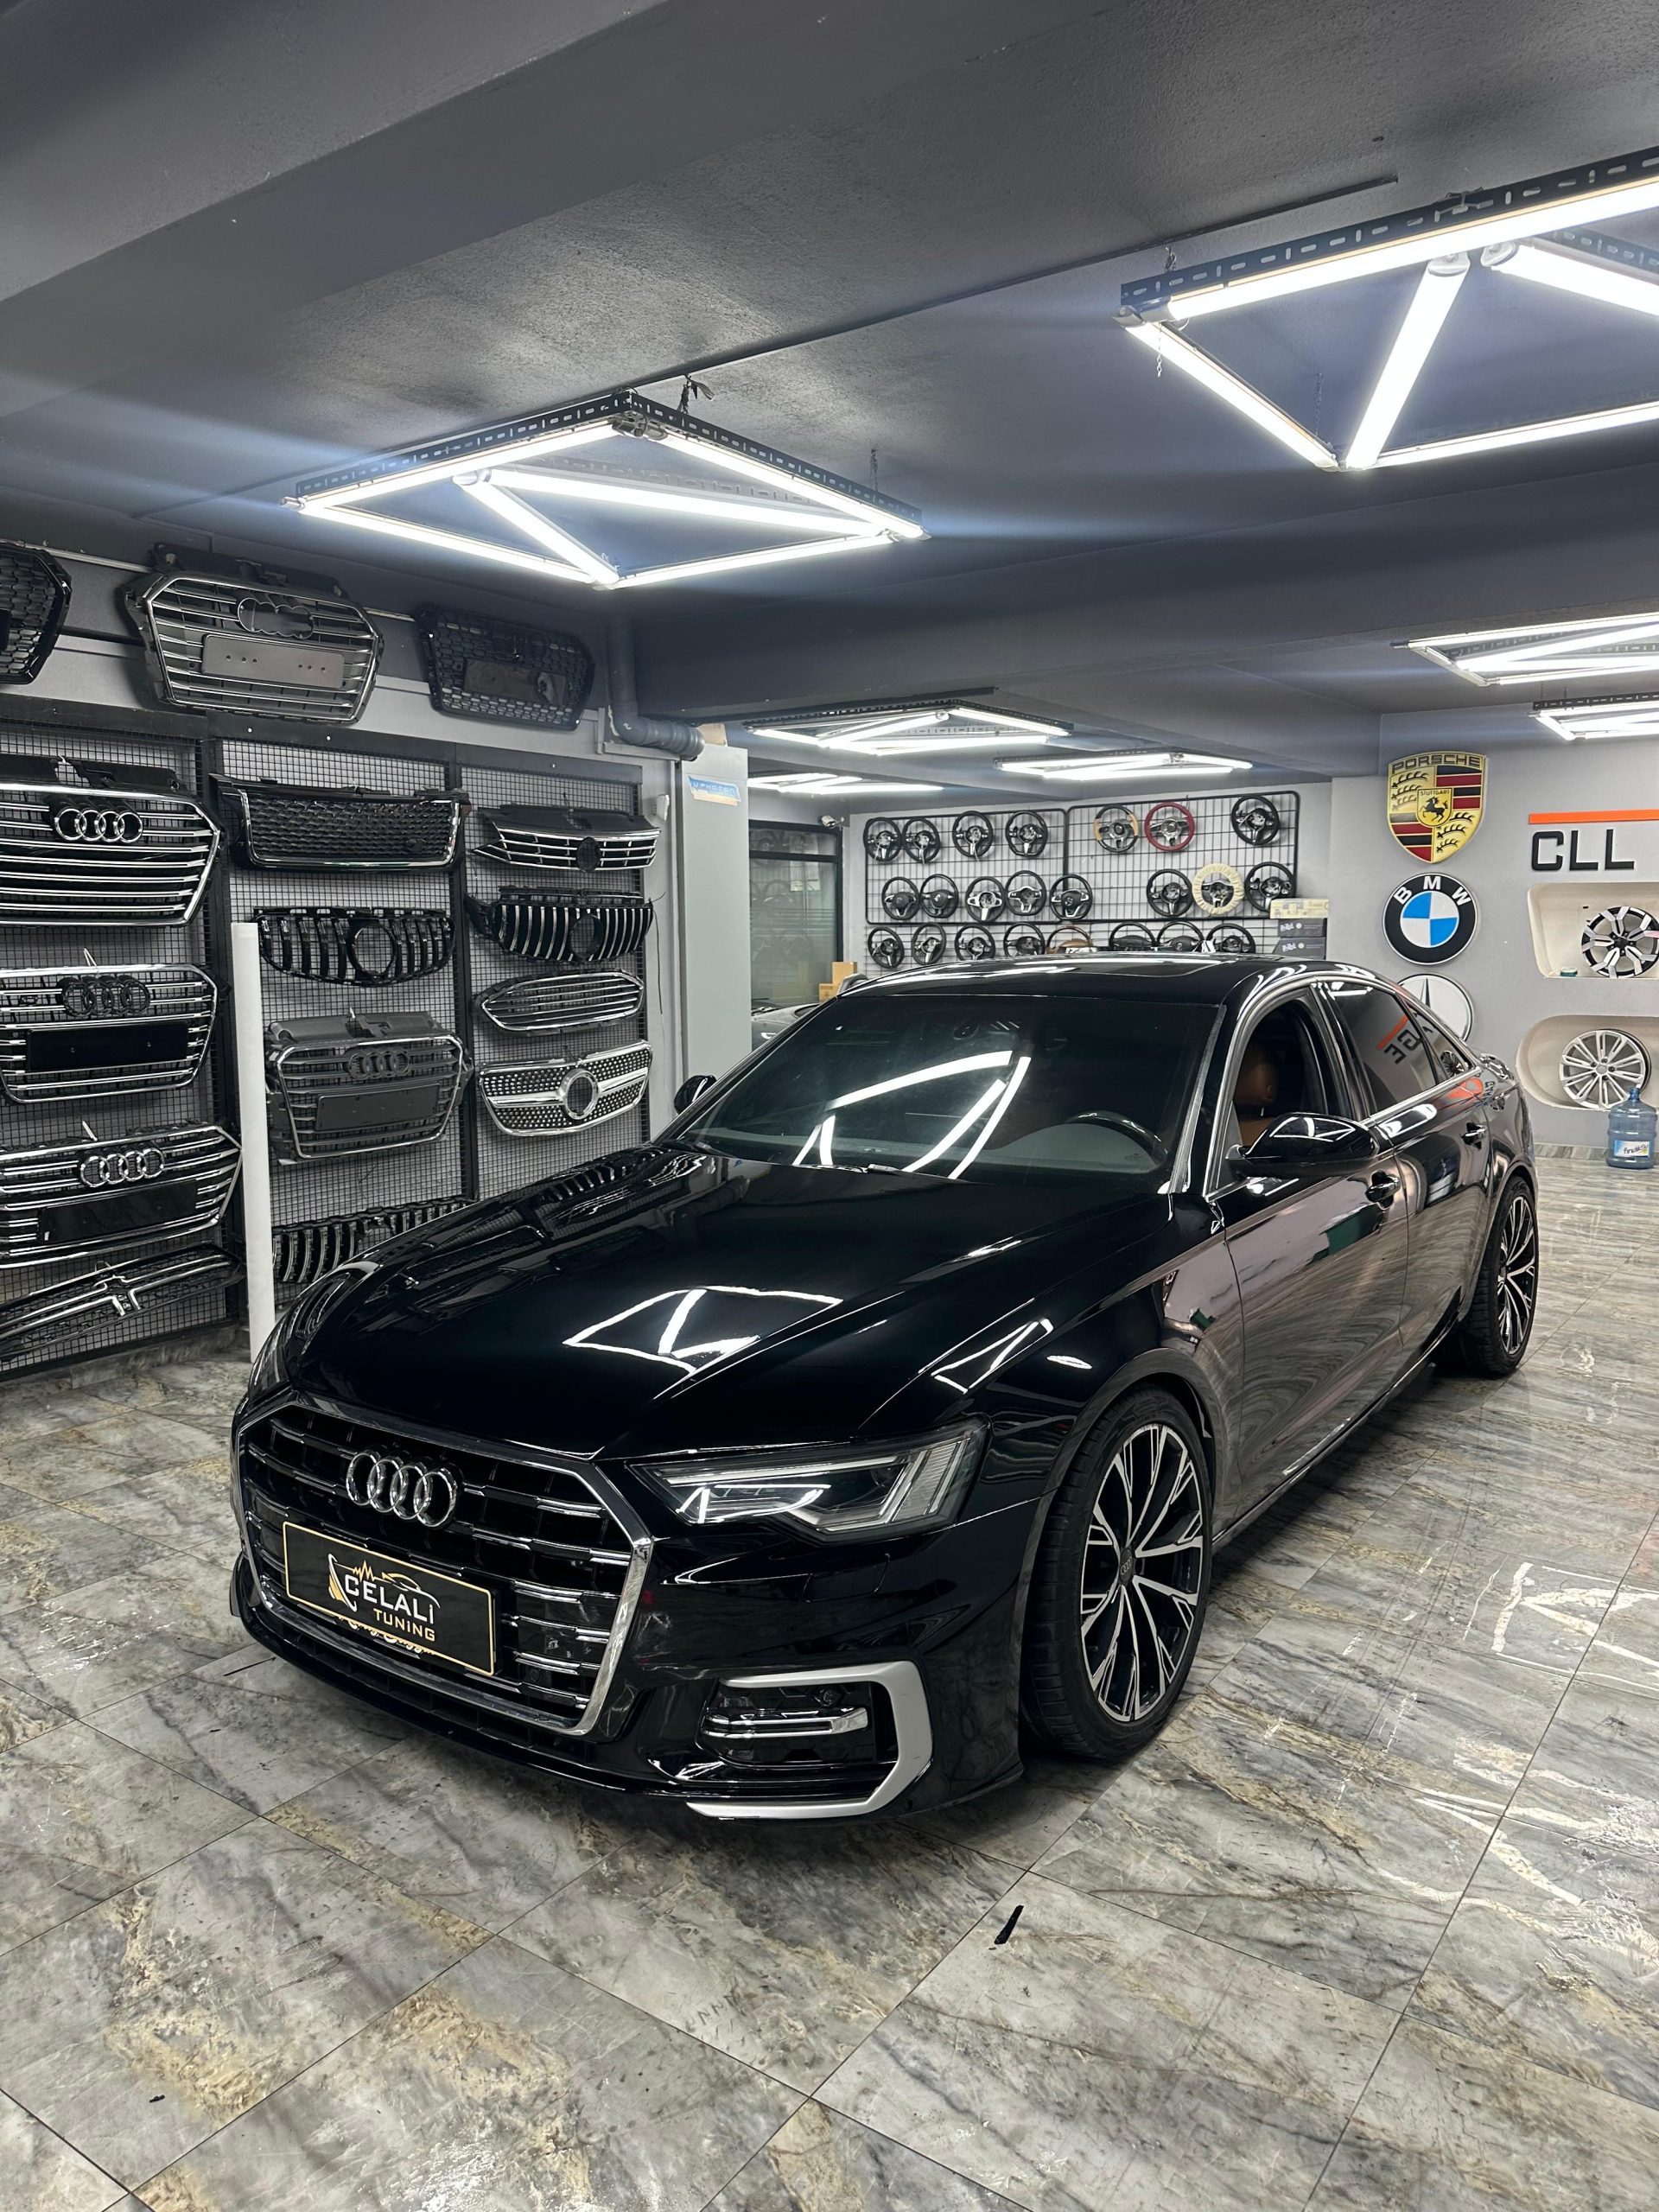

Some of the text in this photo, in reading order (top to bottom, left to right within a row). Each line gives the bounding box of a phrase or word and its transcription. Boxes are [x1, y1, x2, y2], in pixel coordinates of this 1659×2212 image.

[1392, 754, 1480, 774] PORSCHE
[1531, 829, 1635, 871] CLL
[1393, 875, 1472, 906] BMW
